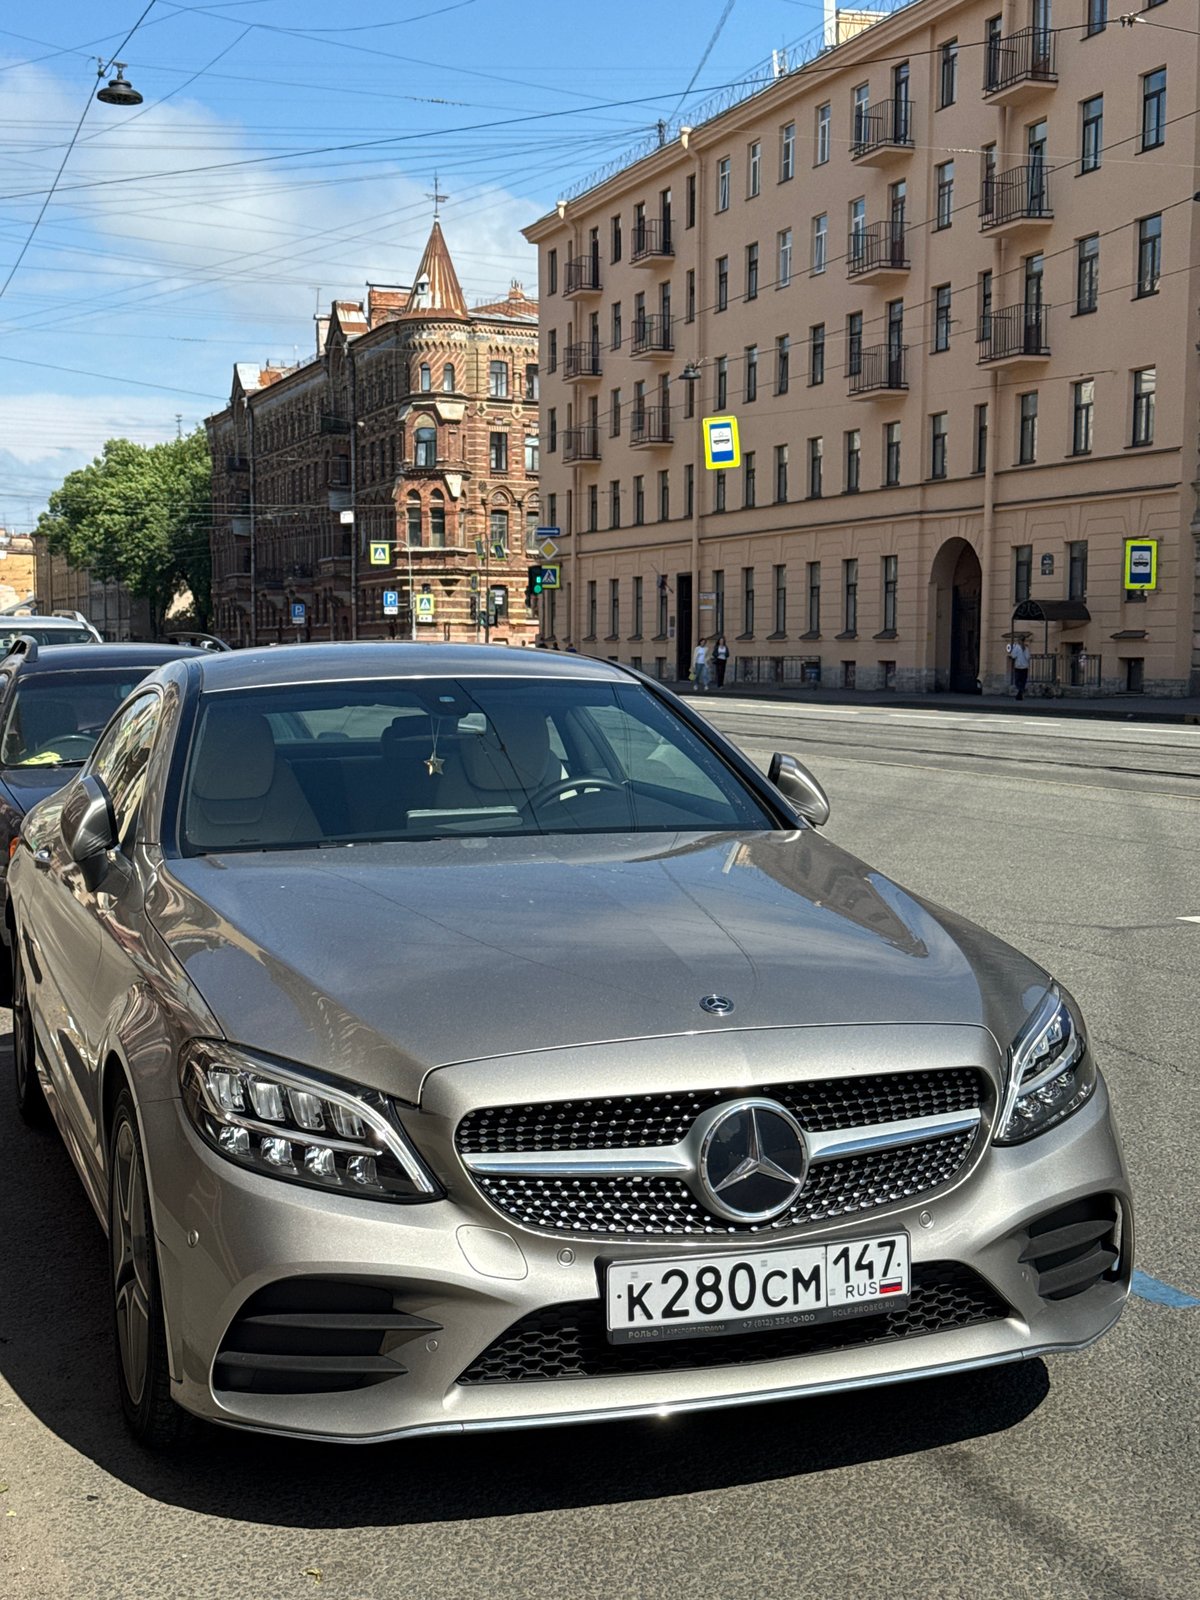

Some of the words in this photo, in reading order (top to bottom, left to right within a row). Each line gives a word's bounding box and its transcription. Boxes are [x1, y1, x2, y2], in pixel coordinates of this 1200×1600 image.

[627, 1262, 821, 1321] К280СМ
[833, 1240, 896, 1283] 147
[846, 1282, 878, 1298] RUS
[628, 1330, 659, 1339] РОЛЬФ
